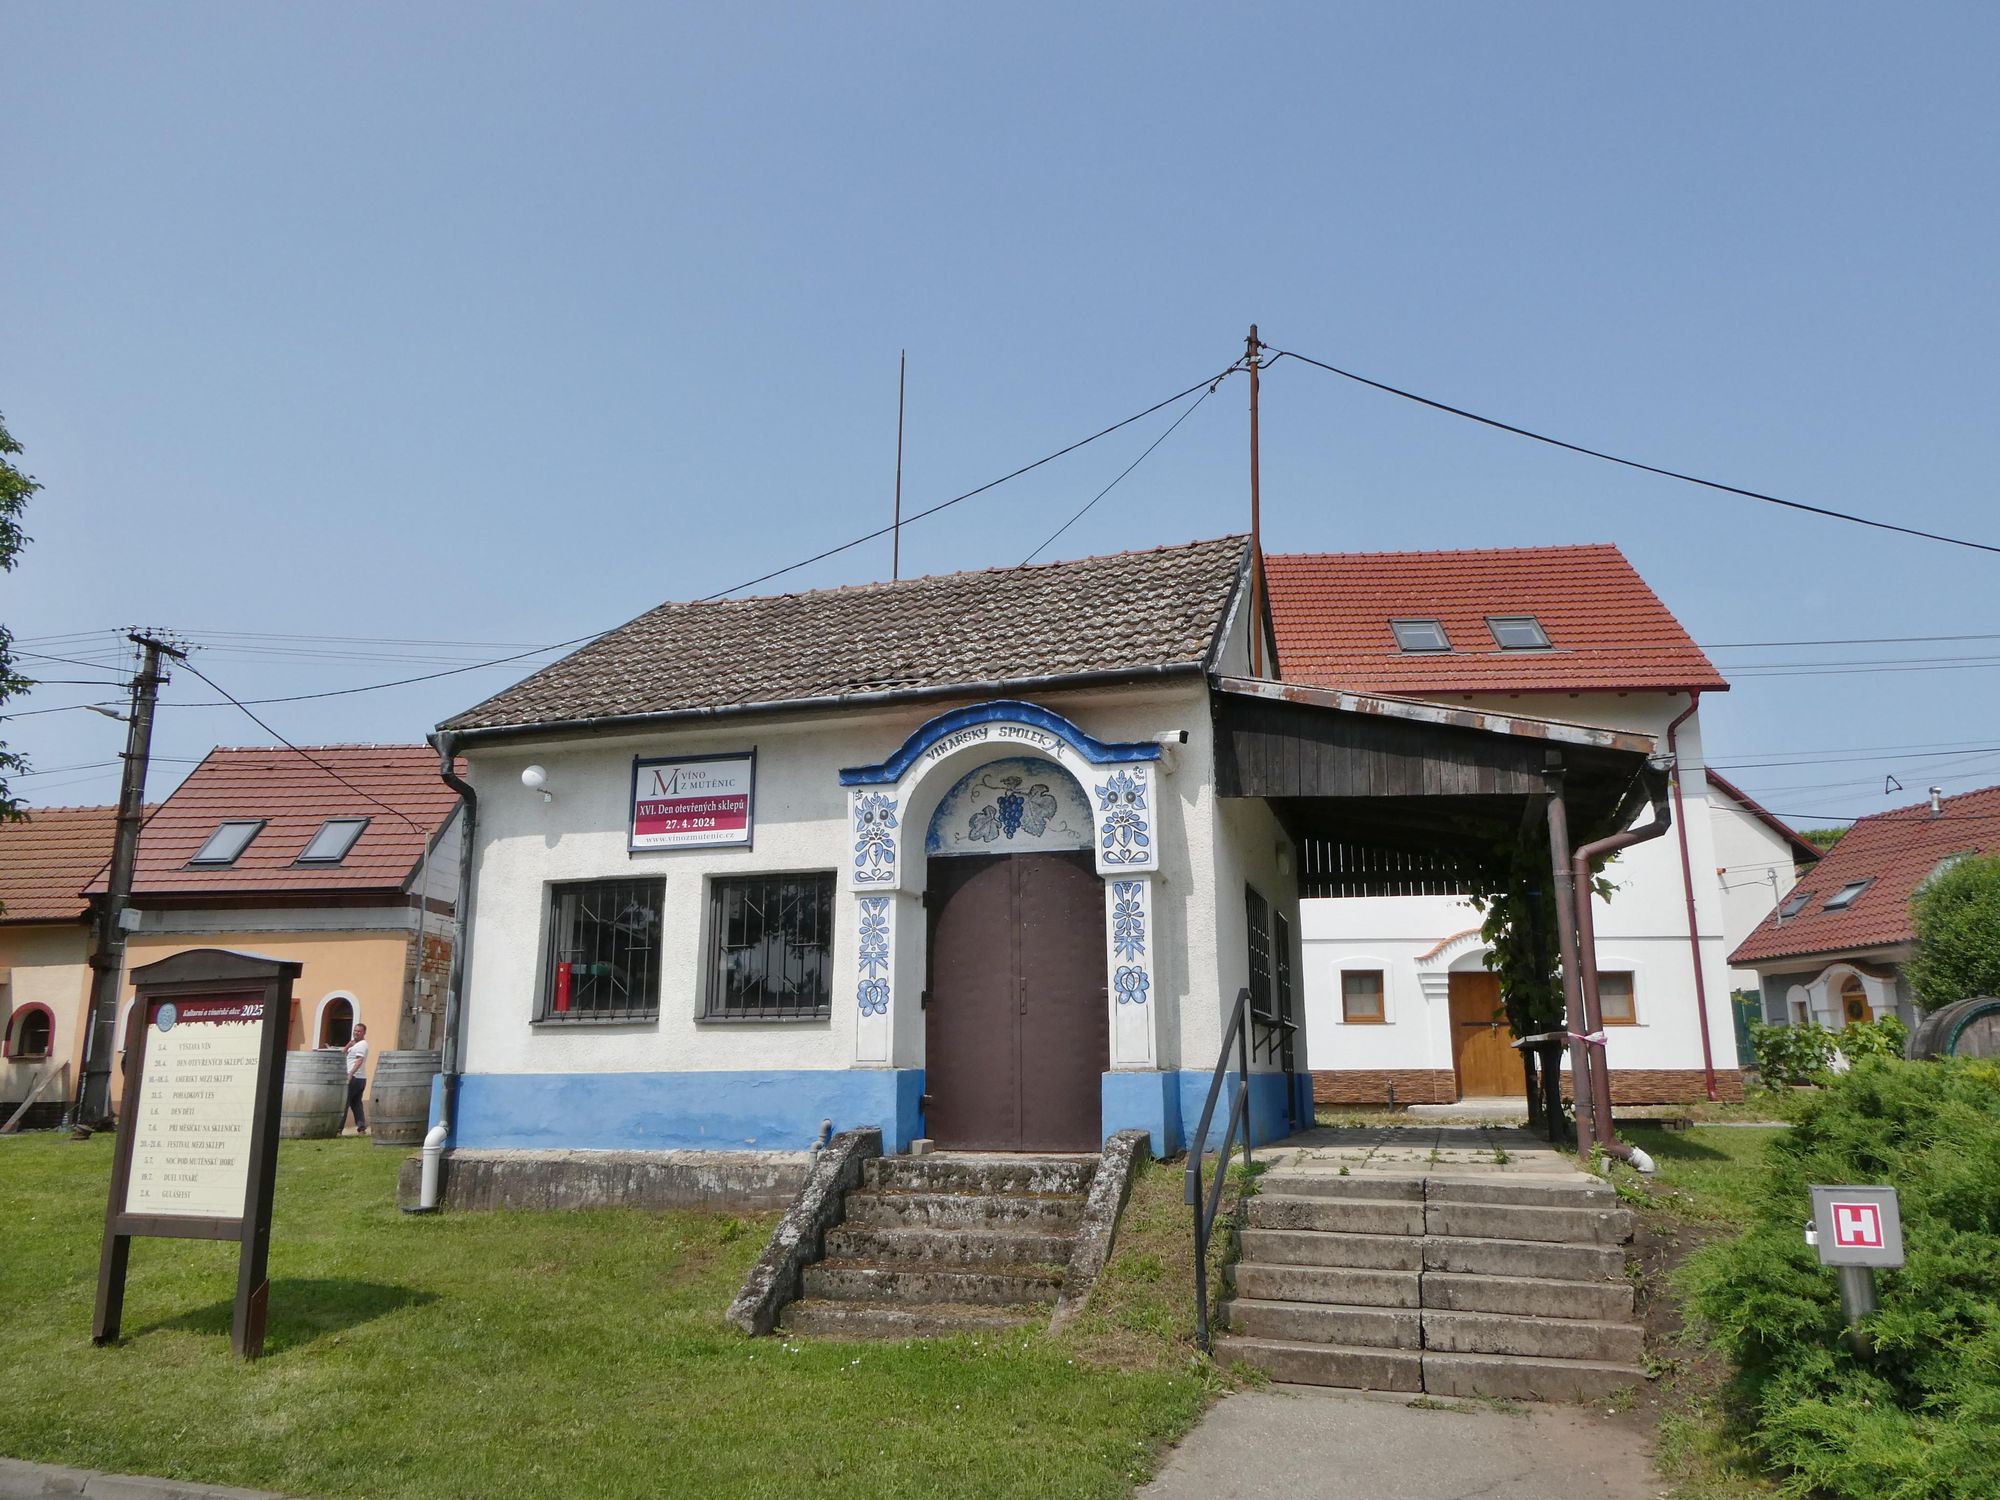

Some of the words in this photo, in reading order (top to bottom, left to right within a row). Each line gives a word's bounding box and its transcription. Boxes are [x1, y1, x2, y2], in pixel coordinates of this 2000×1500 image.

[925, 725, 989, 760] VINAŘSKÝ
[681, 771, 706, 780] VÍNO
[690, 779, 736, 789] MUTĚNIC
[640, 805, 656, 815] XVI.
[658, 804, 674, 814] Den
[675, 800, 716, 814] otevřených
[718, 799, 744, 812] sklepů
[665, 820, 680, 829] 27.
[682, 819, 691, 828] 4.
[693, 818, 715, 827] 2024
[241, 1005, 264, 1016] 2025
[177, 1059, 188, 1067] DEN
[245, 1057, 258, 1065] 2025
[1838, 1208, 1877, 1243] H
